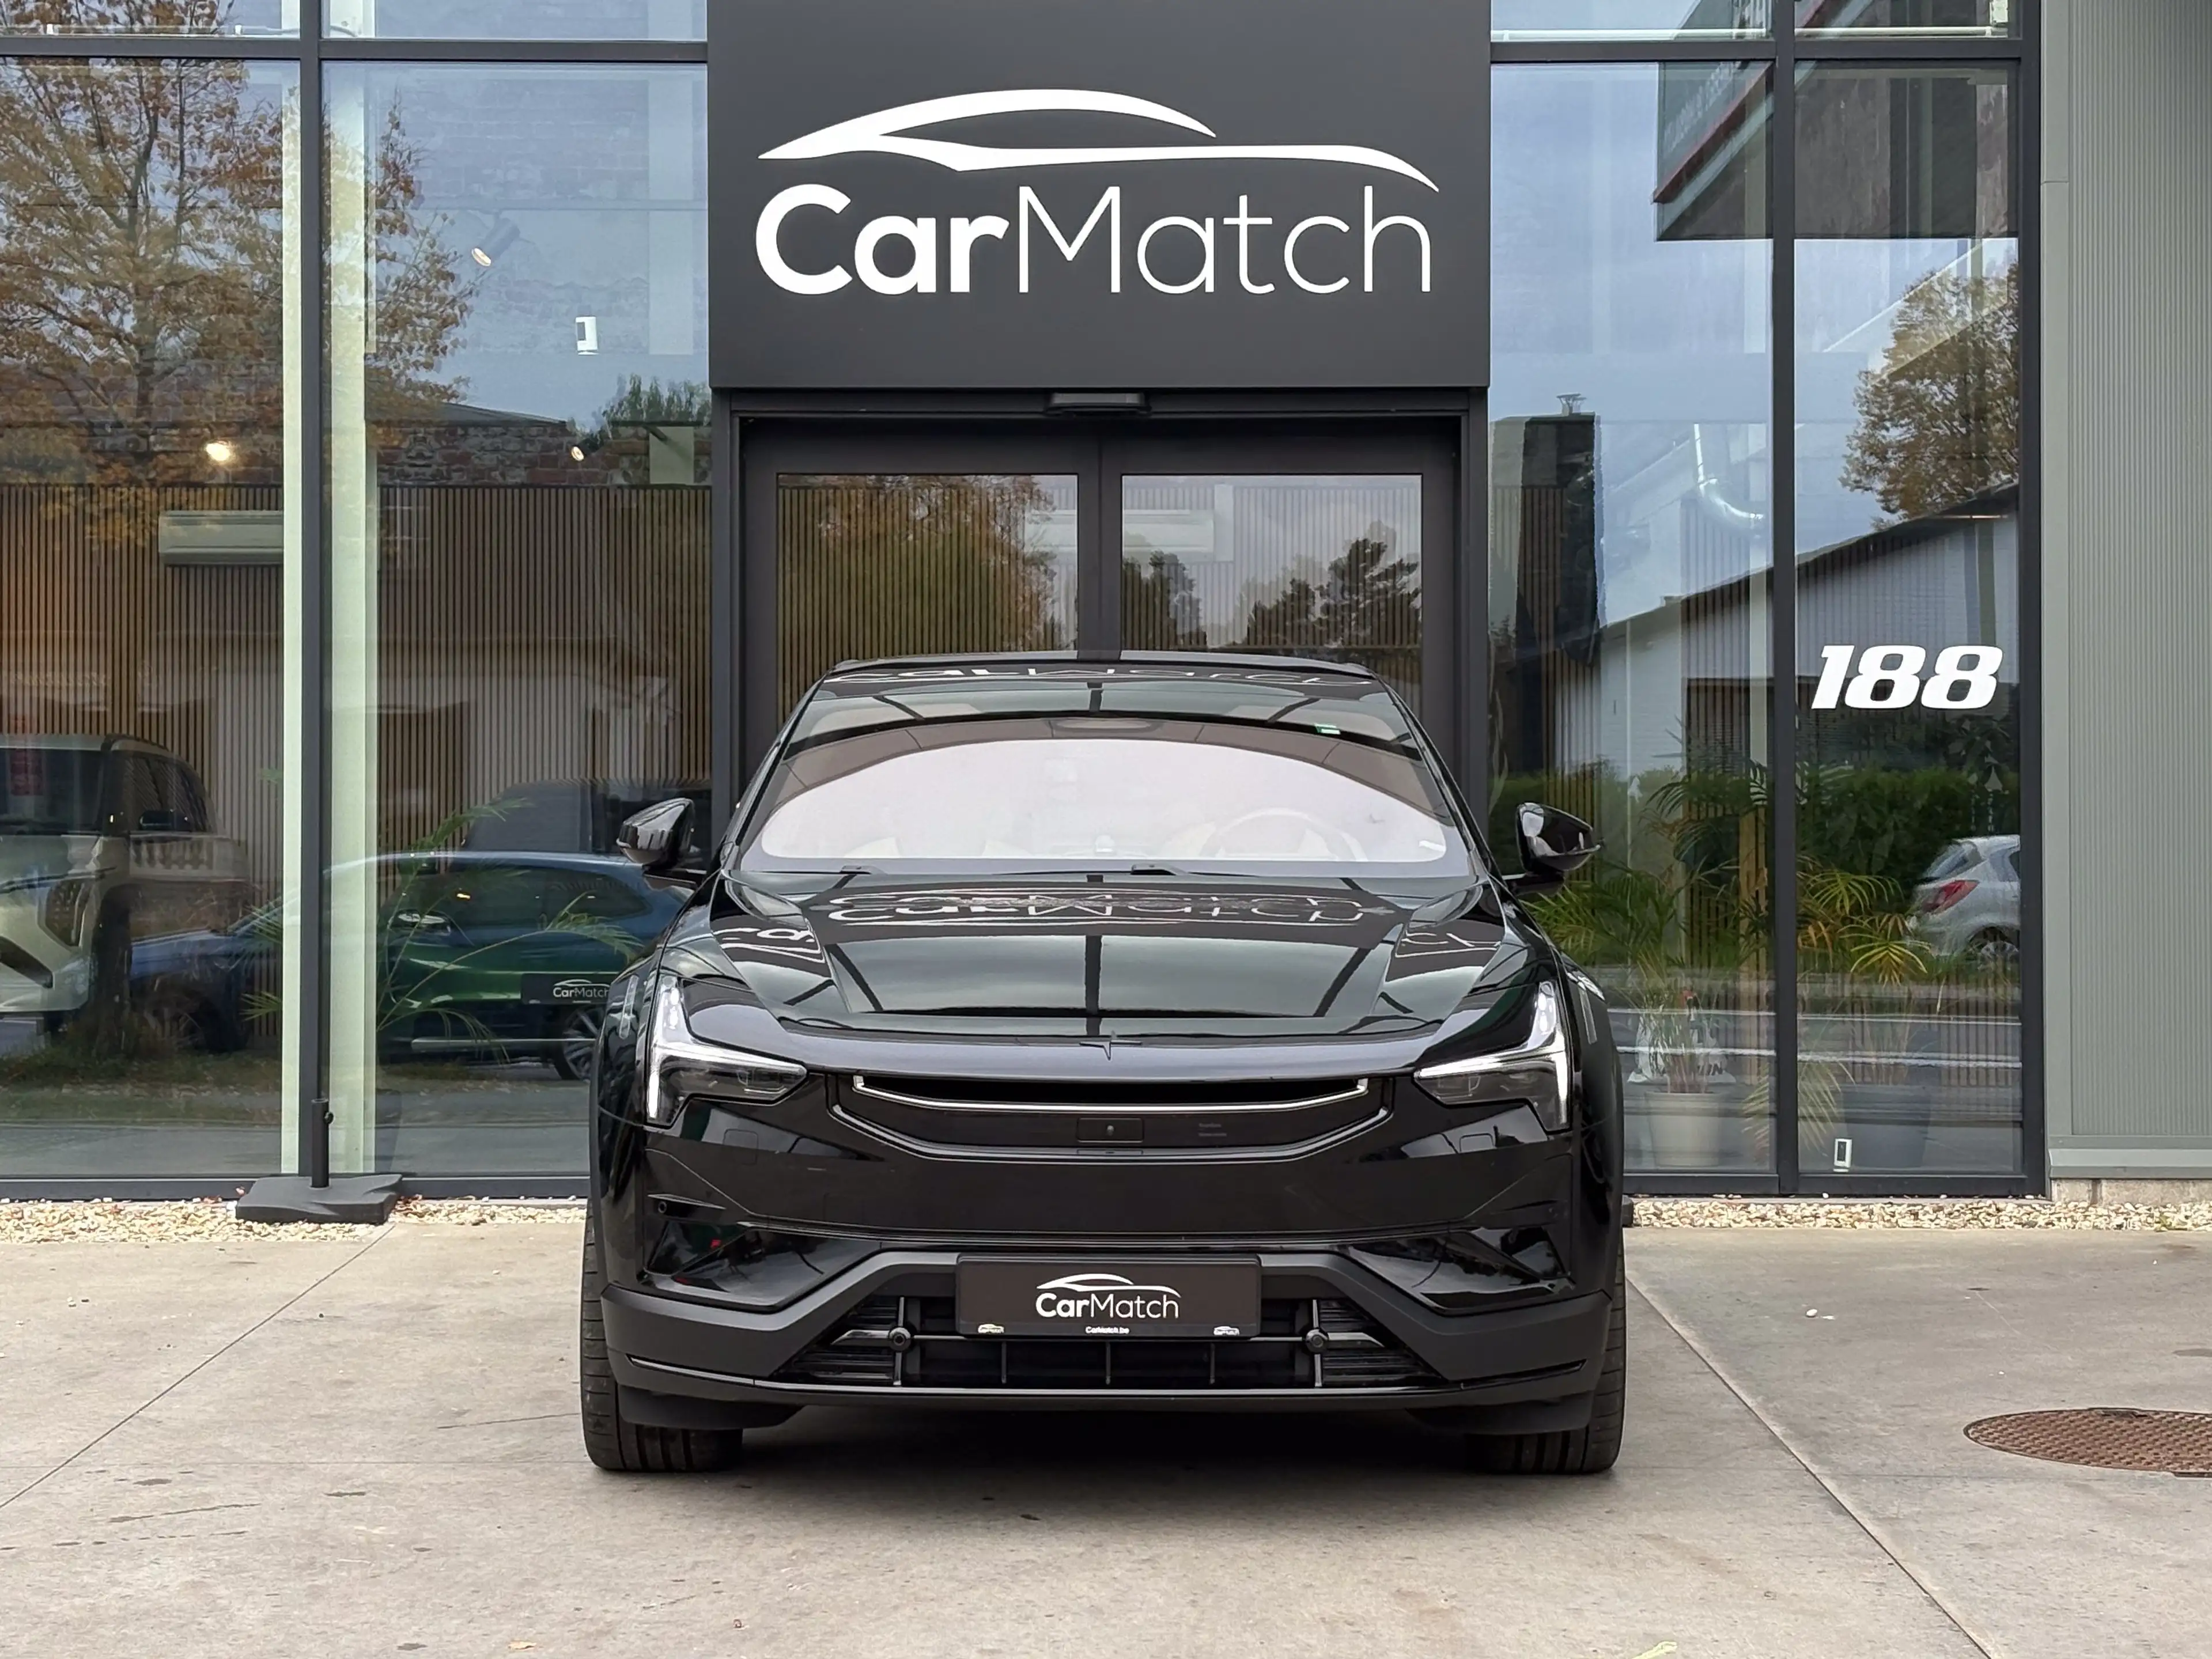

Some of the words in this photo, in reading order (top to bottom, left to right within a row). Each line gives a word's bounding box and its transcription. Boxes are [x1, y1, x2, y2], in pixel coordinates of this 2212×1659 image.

[756, 184, 1431, 295] CarMatch
[1812, 645, 2003, 709] 188
[1036, 1293, 1179, 1319] CarMatch
